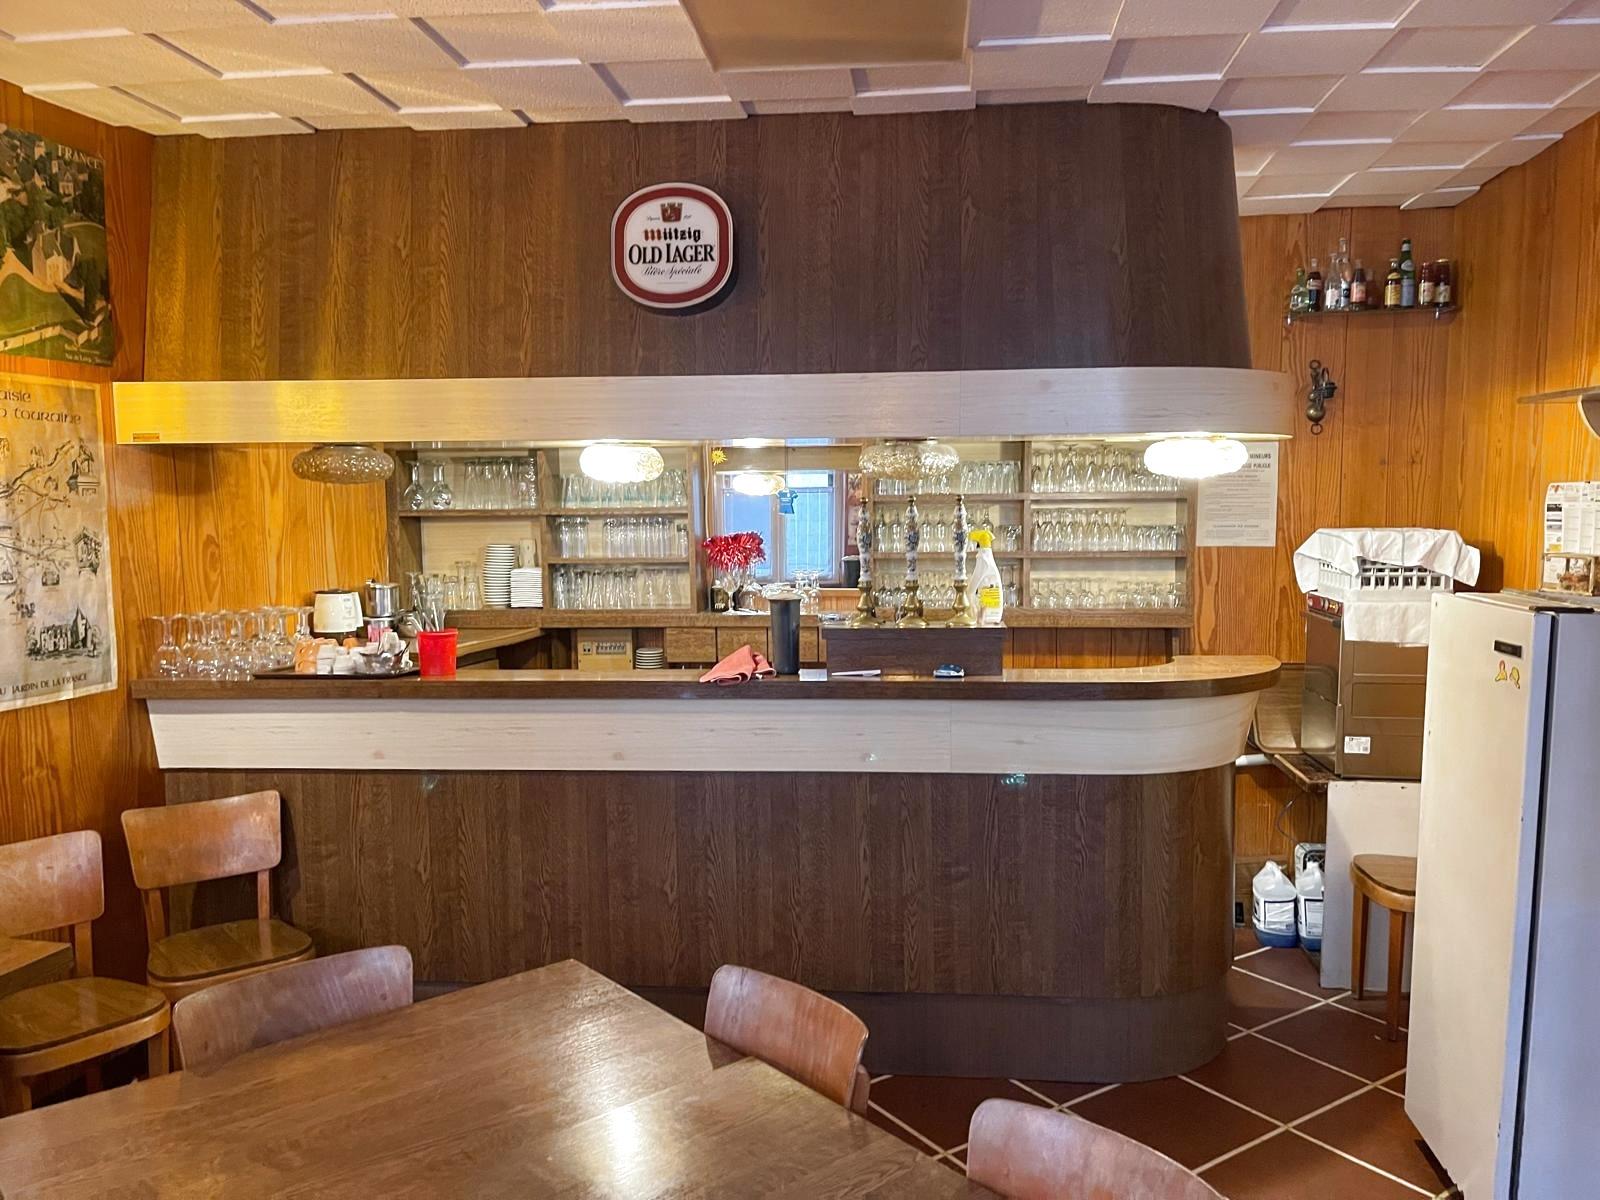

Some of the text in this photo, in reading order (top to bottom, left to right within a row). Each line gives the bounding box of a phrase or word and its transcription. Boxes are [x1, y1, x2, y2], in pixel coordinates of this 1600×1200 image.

[58, 144, 103, 169] FRANCE
[628, 243, 715, 264] OLD LAGER
[12, 681, 38, 695] JARDIN
[40, 679, 50, 689] DE
[52, 676, 61, 688] LA
[61, 672, 87, 686] FRANCE
